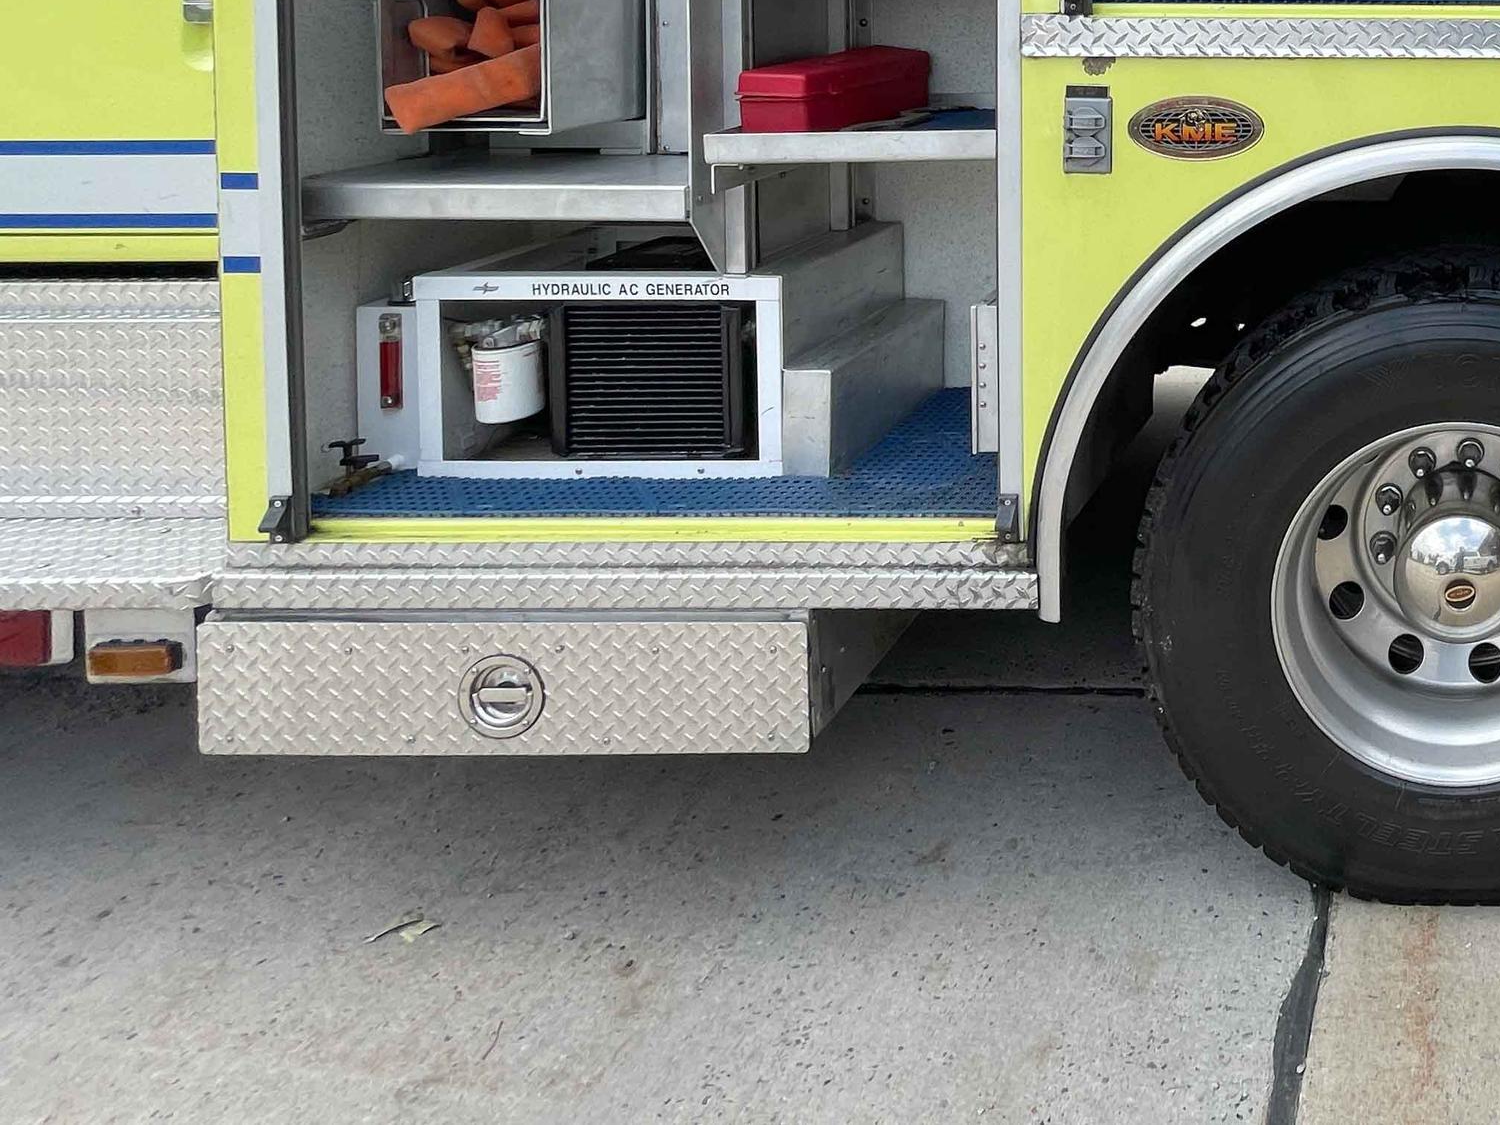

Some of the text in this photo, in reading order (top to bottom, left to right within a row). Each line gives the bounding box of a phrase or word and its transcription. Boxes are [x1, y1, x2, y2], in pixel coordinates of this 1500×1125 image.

[1154, 122, 1238, 142] KME
[532, 282, 611, 296] HYDRAULIC
[646, 283, 730, 296] GENERATOR
